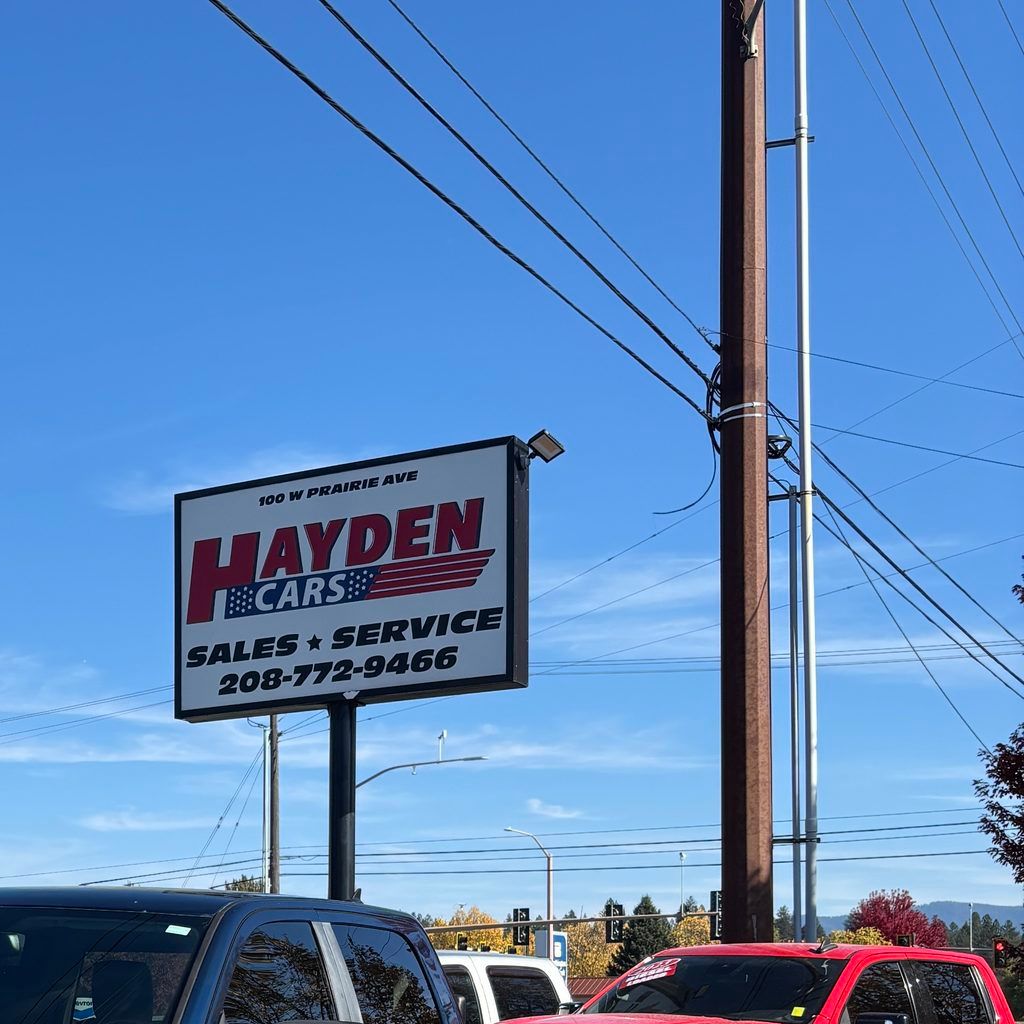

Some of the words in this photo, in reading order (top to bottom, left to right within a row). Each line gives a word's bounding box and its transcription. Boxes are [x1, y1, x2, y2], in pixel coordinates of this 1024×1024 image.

[258, 492, 285, 506] 100
[288, 490, 305, 502] W
[307, 476, 380, 499] PRAIRIE
[381, 470, 418, 486] AVE
[186, 497, 485, 625] HAYDEN
[254, 573, 347, 613] CARS
[186, 634, 299, 668] SALES
[331, 607, 504, 649] SERVICE
[218, 646, 459, 695] 208-772-9466
